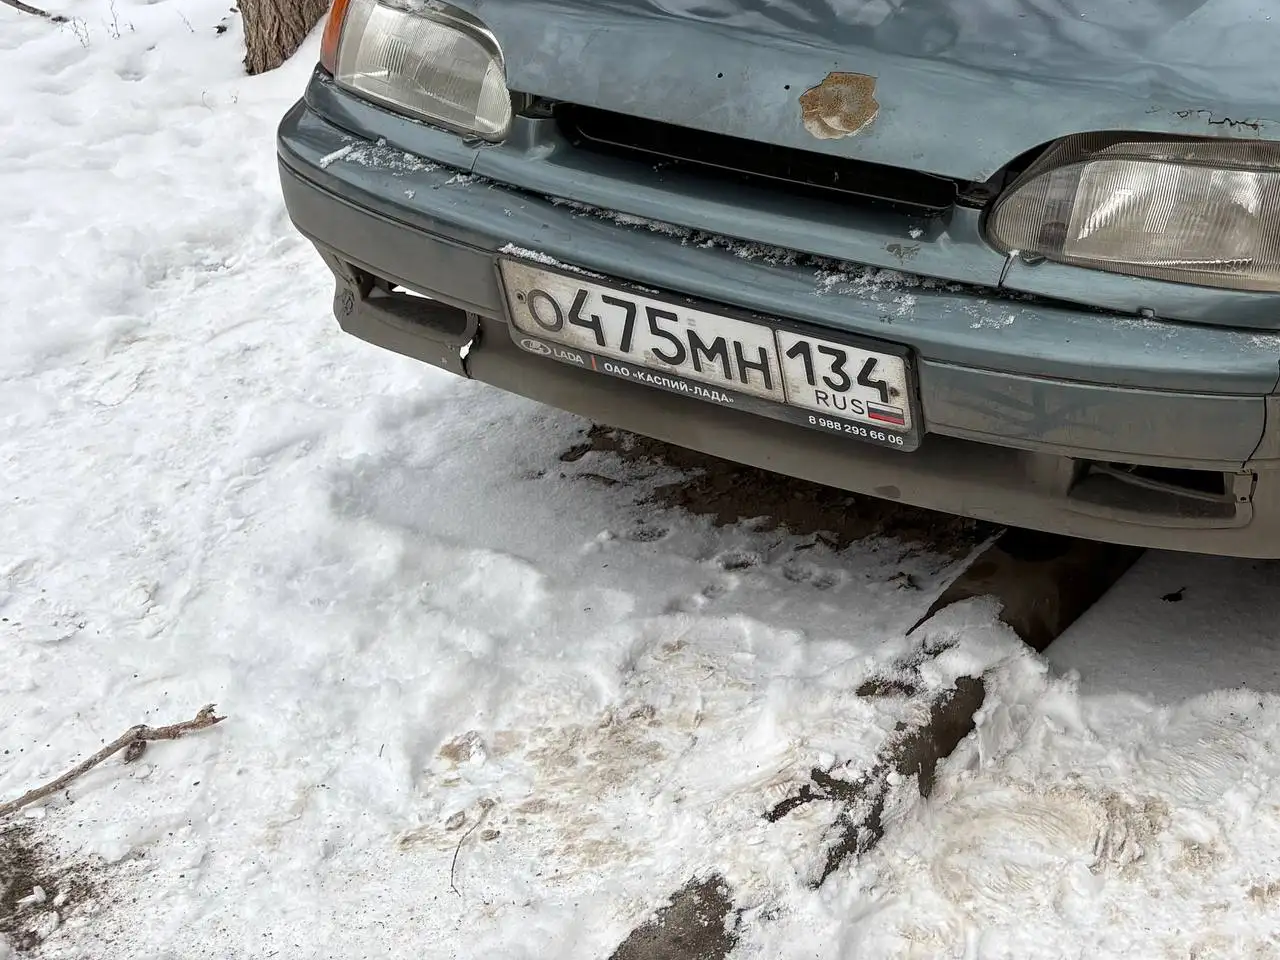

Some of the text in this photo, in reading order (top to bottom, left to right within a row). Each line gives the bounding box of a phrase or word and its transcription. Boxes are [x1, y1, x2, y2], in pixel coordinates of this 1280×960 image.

[553, 348, 584, 364] LADA
[604, 363, 630, 376] ОАО
[786, 341, 889, 403] 134
[815, 390, 865, 415] RUS
[808, 415, 904, 446] 8 988 293 66 06
